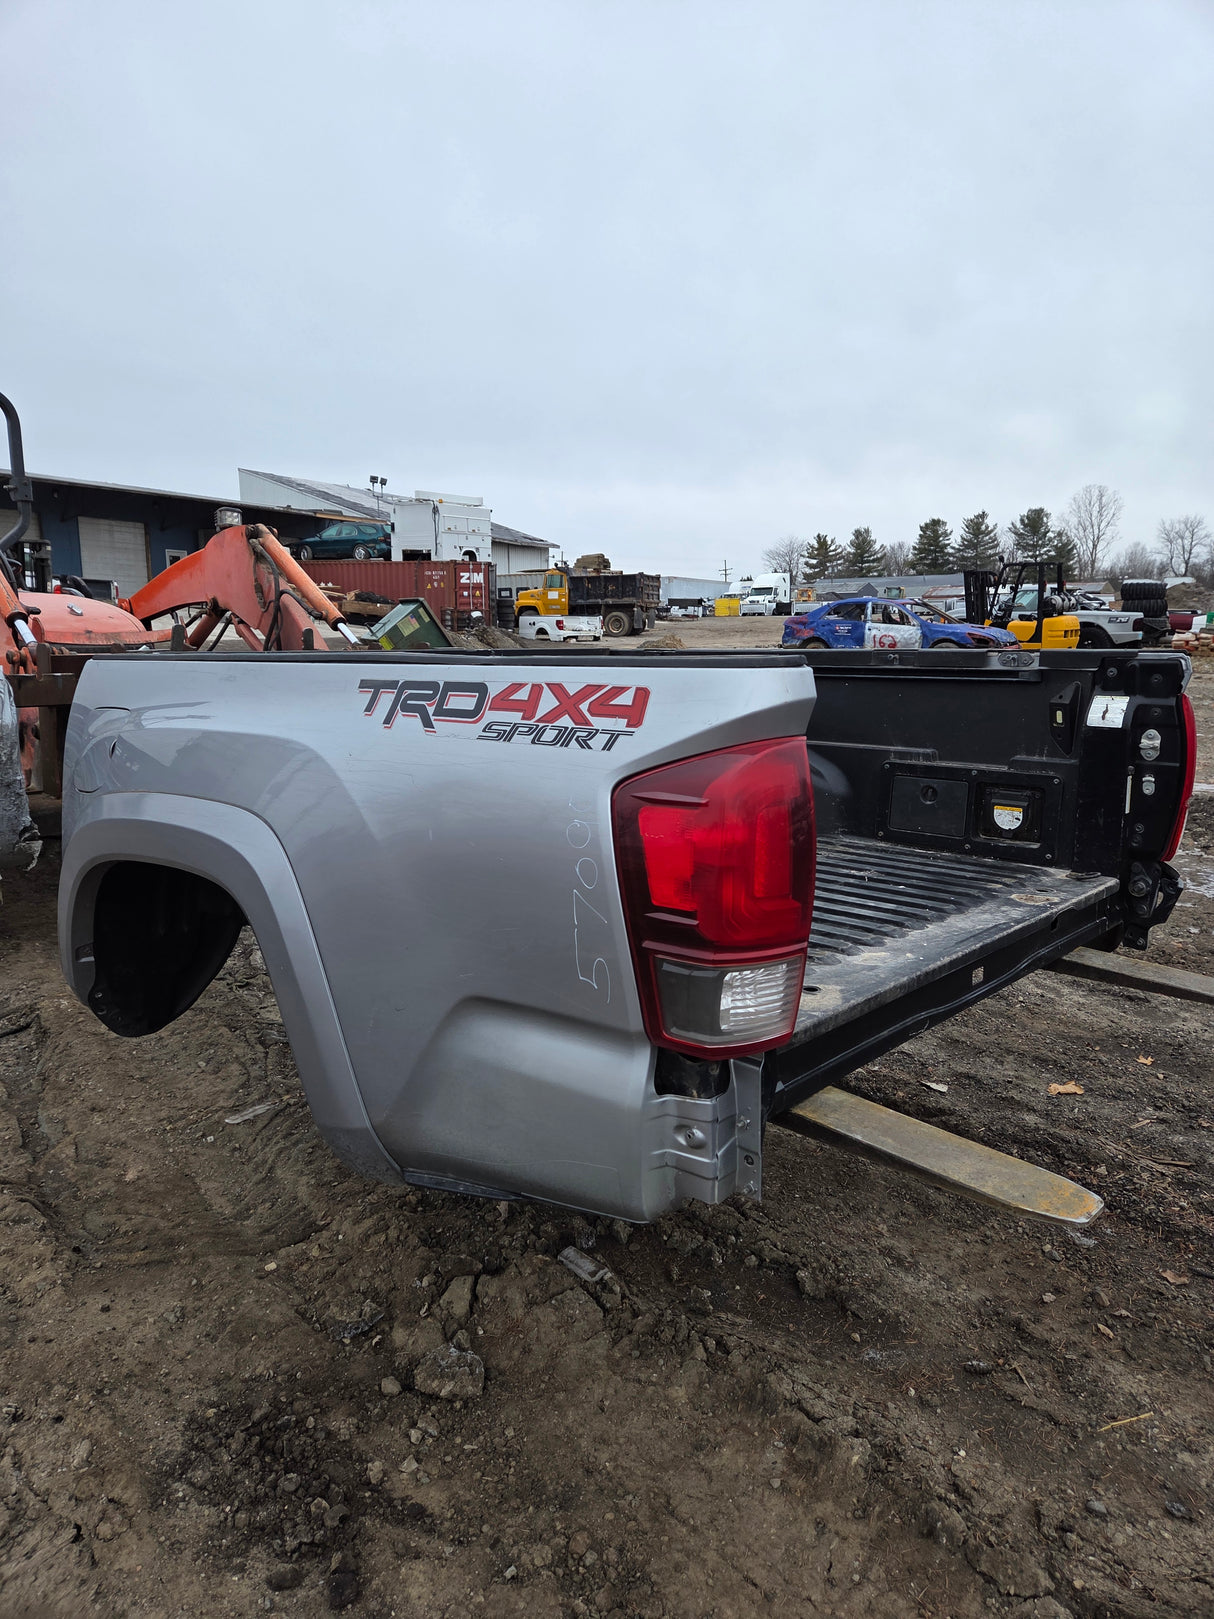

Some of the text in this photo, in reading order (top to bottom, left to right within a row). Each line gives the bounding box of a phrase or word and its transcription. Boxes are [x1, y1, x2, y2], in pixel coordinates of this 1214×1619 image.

[460, 572, 483, 583] ZIM
[358, 679, 651, 733] TRD 4X4
[476, 721, 635, 751] SPORT
